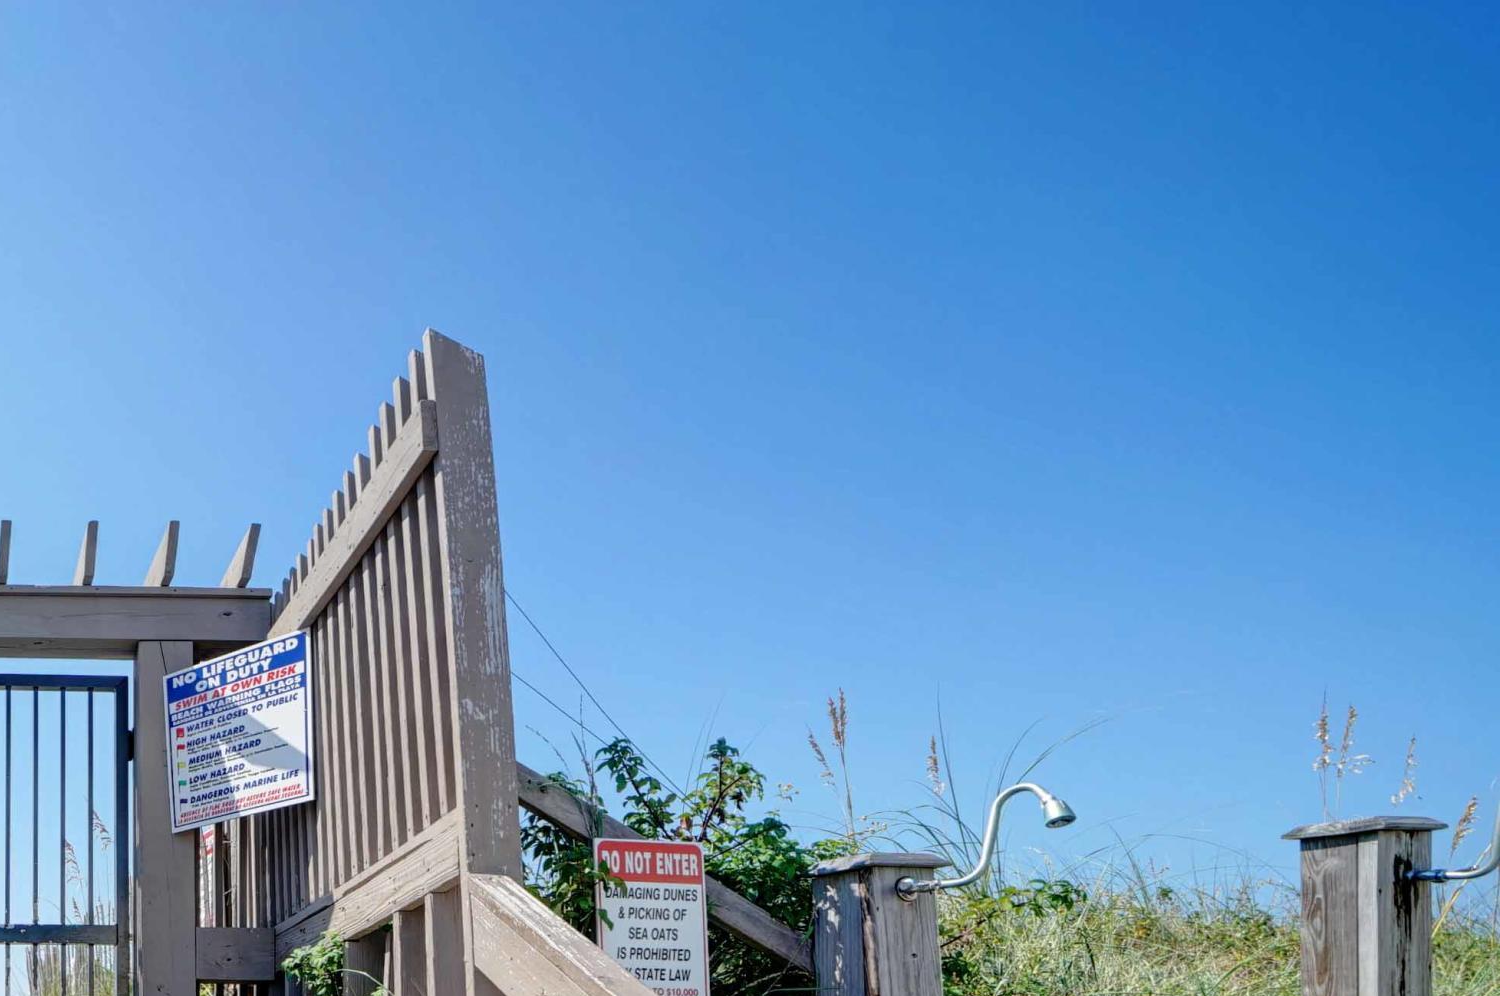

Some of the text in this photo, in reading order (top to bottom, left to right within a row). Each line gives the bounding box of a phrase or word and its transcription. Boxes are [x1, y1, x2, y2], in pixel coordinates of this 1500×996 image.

[172, 637, 298, 689] NO LIFEGUARD
[195, 658, 272, 693] ON DUTY
[171, 675, 301, 722] BEACH WARNING FLAGS
[175, 664, 297, 711] SWIM AT OWN RISK
[186, 718, 214, 732] WATER
[217, 707, 248, 723] CLOSED
[251, 703, 263, 713] TO
[266, 692, 298, 709] PUBLIC
[187, 736, 207, 748] HIGH
[210, 725, 246, 740] HAZARD
[188, 749, 222, 766] MEDIUM
[225, 738, 262, 755] HAZARD
[189, 773, 208, 785] LOW
[210, 763, 245, 779] HAZARD
[190, 784, 240, 804] DANGEROUS
[243, 774, 279, 790] MARINE
[281, 769, 300, 780] LIFE
[624, 851, 651, 874] NOT
[656, 852, 698, 876] ENTER
[663, 888, 698, 902] DUNES
[618, 907, 687, 921] & PICKING OF
[628, 927, 678, 941] SEA OATS
[617, 947, 691, 962] IS PROHIBITED
[635, 967, 666, 981] STATE
[669, 969, 691, 981] LAW
